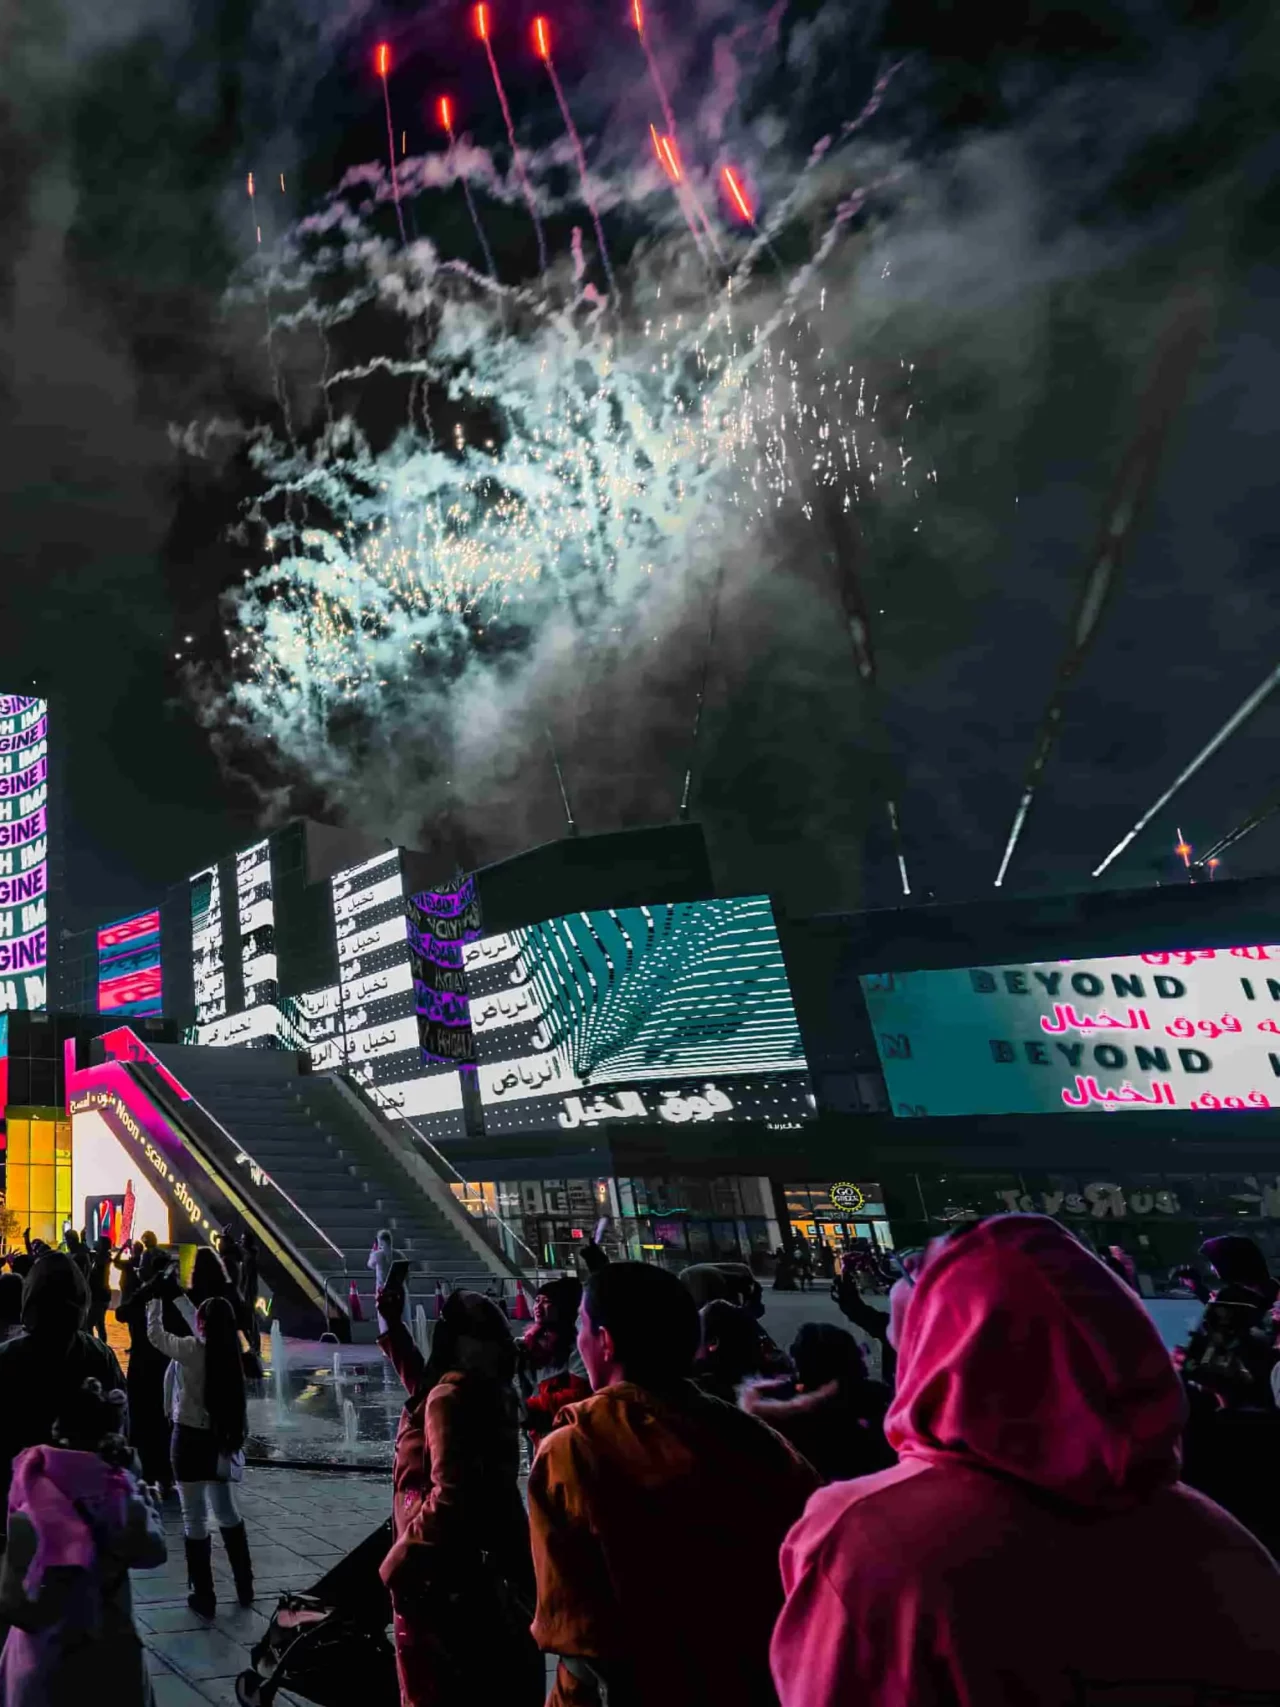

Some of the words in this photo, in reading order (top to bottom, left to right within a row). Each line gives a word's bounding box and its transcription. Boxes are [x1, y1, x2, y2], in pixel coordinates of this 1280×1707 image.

[969, 970, 1188, 1001] BEYOND
[1040, 1002, 1151, 1036] الخيال
[1165, 1012, 1243, 1039] فوق
[362, 1028, 397, 1053] تخيل
[988, 1040, 1214, 1074] BEYOND
[658, 1083, 734, 1123] فوق
[1061, 1076, 1177, 1112] الخيال
[116, 1102, 139, 1139] Noon
[145, 1147, 167, 1177] scan
[174, 1182, 201, 1221] shop
[836, 1187, 854, 1196] GO
